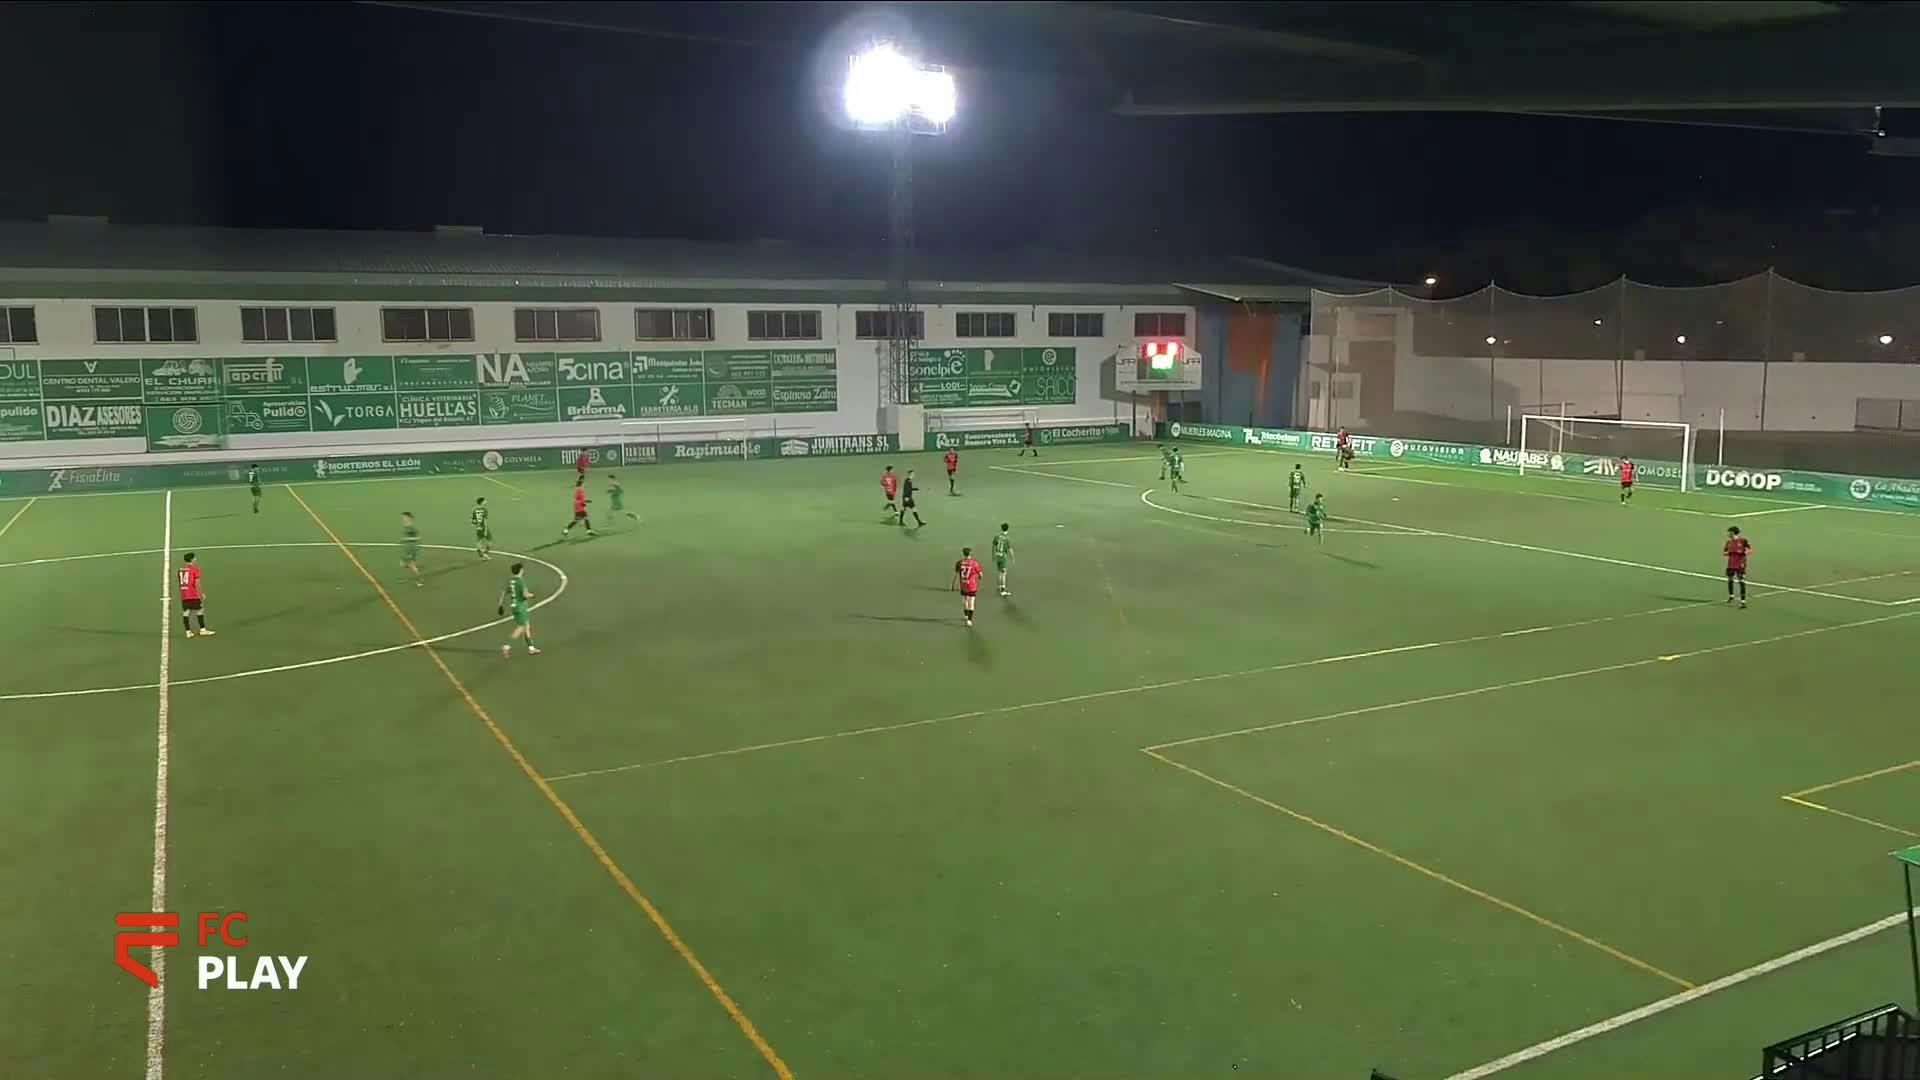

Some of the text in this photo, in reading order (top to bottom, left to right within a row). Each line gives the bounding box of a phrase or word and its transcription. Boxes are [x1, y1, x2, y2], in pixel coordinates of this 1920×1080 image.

[476, 354, 530, 383] NA
[558, 358, 623, 380] 5cina
[43, 377, 76, 385] CENTRO
[144, 378, 163, 386] EL
[345, 405, 394, 418] TORGA
[400, 401, 477, 418] HUELLAS
[46, 406, 142, 427] DIAZ ASESORES
[811, 436, 889, 449] JUMITRANS SL
[329, 460, 380, 470] MORTEROS
[396, 459, 421, 467] LEÓN
[179, 571, 189, 584] 14
